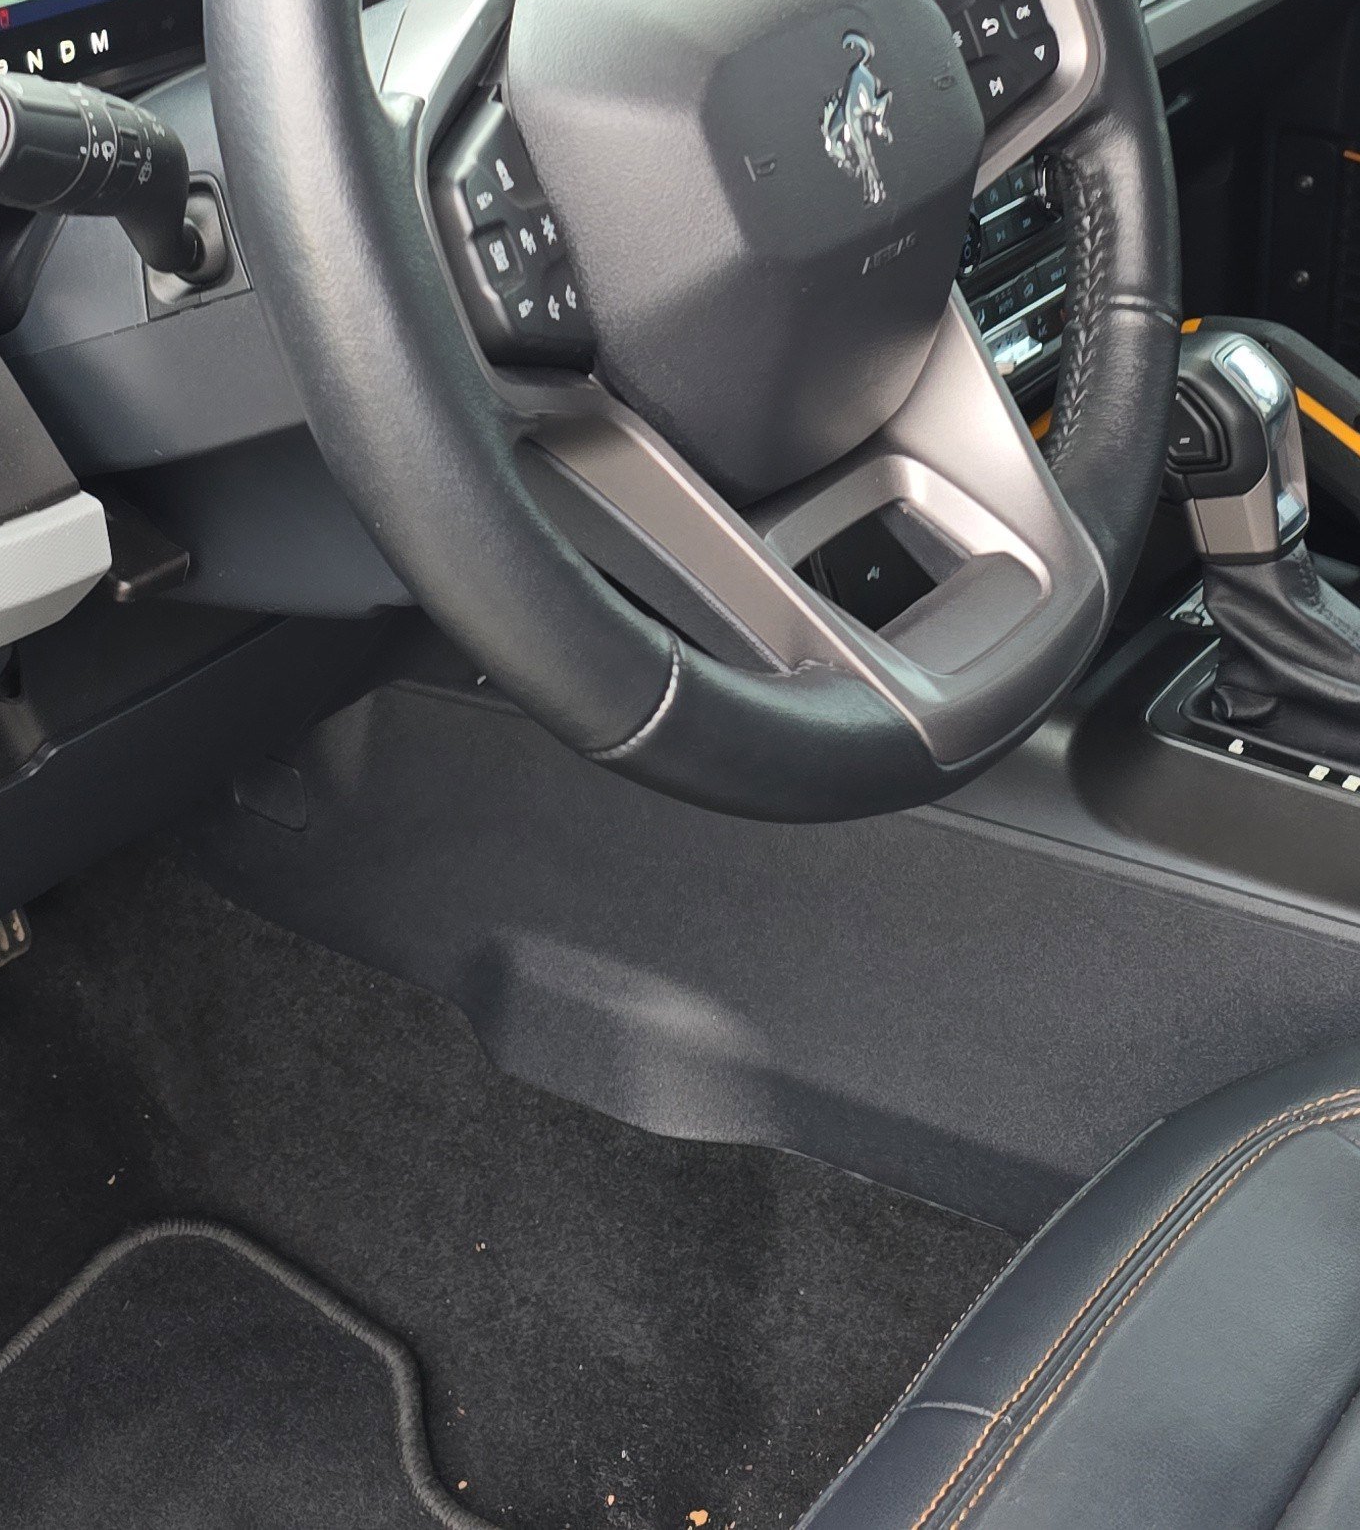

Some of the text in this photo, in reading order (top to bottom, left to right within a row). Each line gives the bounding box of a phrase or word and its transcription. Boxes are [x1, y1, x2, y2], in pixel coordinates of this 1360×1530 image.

[27, 48, 44, 74] N
[59, 39, 75, 64] D
[90, 29, 109, 55] M
